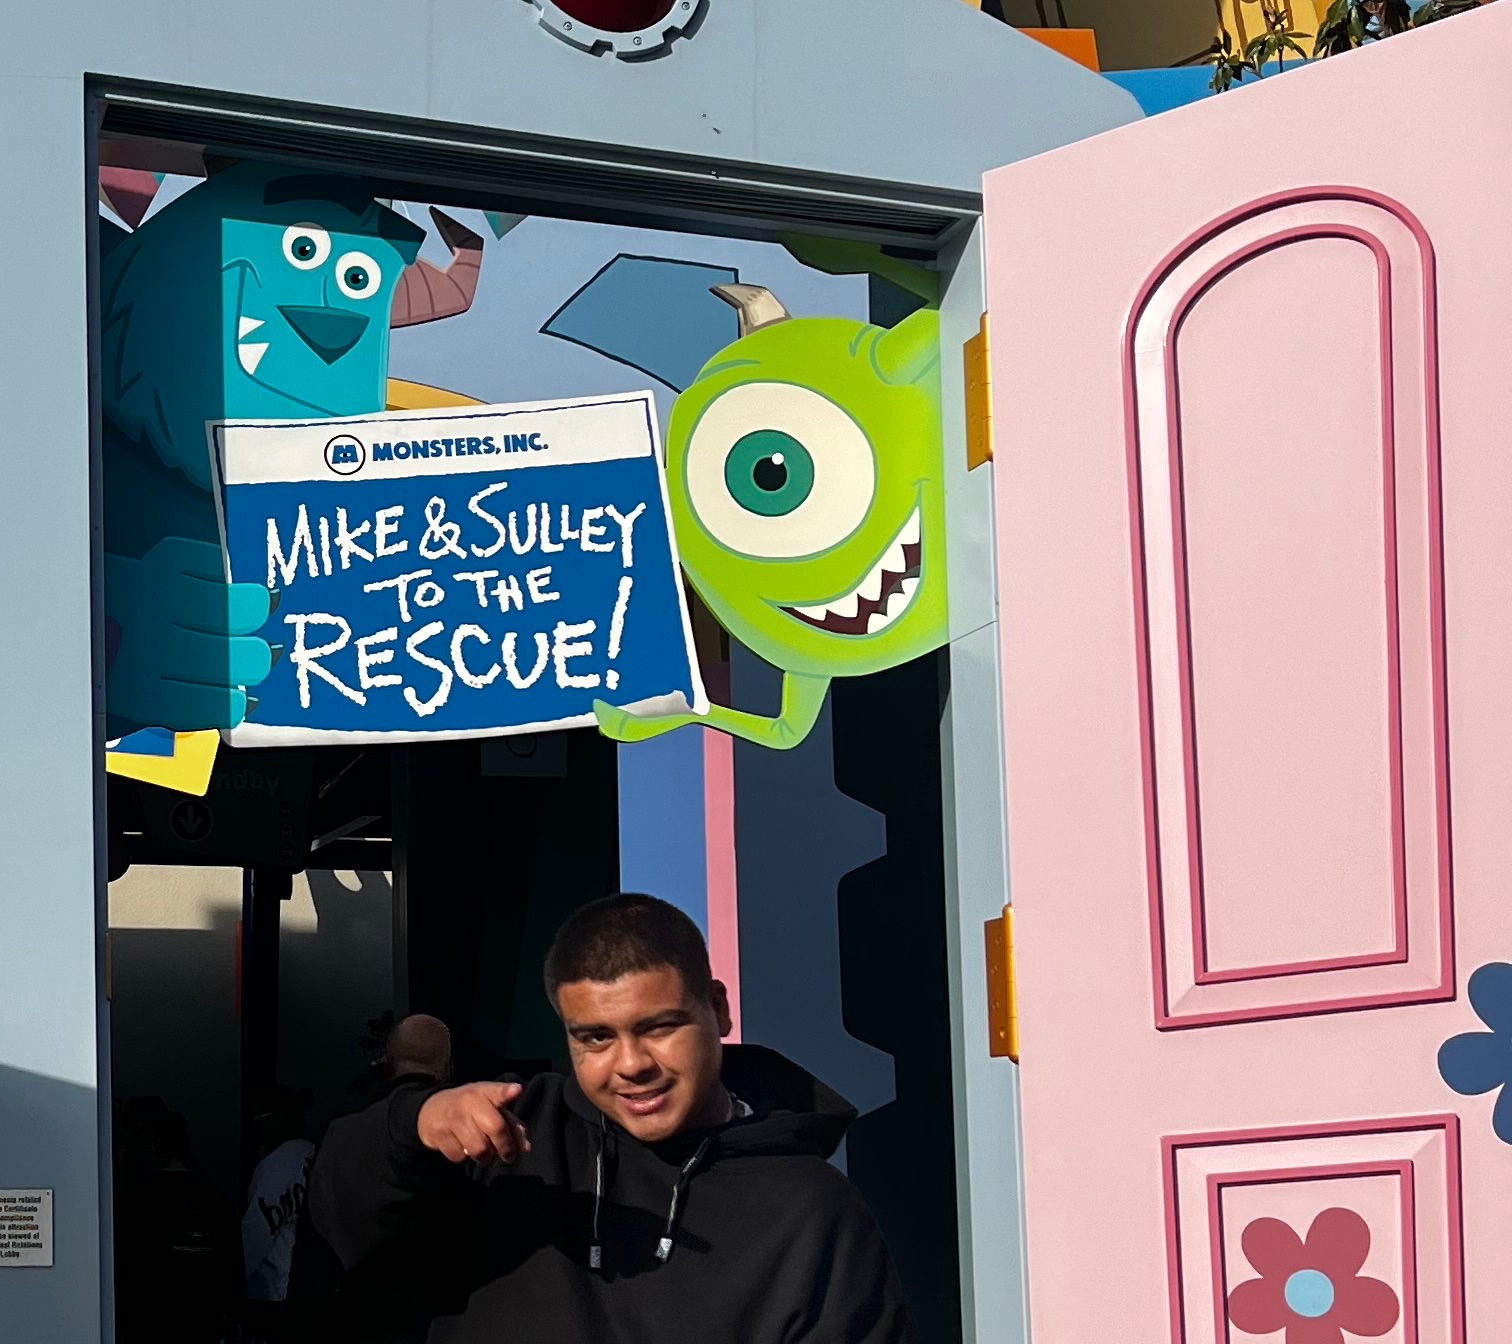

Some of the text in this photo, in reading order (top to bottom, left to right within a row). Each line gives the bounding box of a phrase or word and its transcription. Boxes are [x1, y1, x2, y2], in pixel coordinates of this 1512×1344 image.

[372, 436, 501, 462] MONSTERS,
[504, 433, 549, 454] INC.
[267, 481, 646, 588] MIKE & SULLEY
[364, 566, 560, 622] TO THE
[284, 575, 633, 717] RESCUE!
[218, 768, 280, 796] ndby
